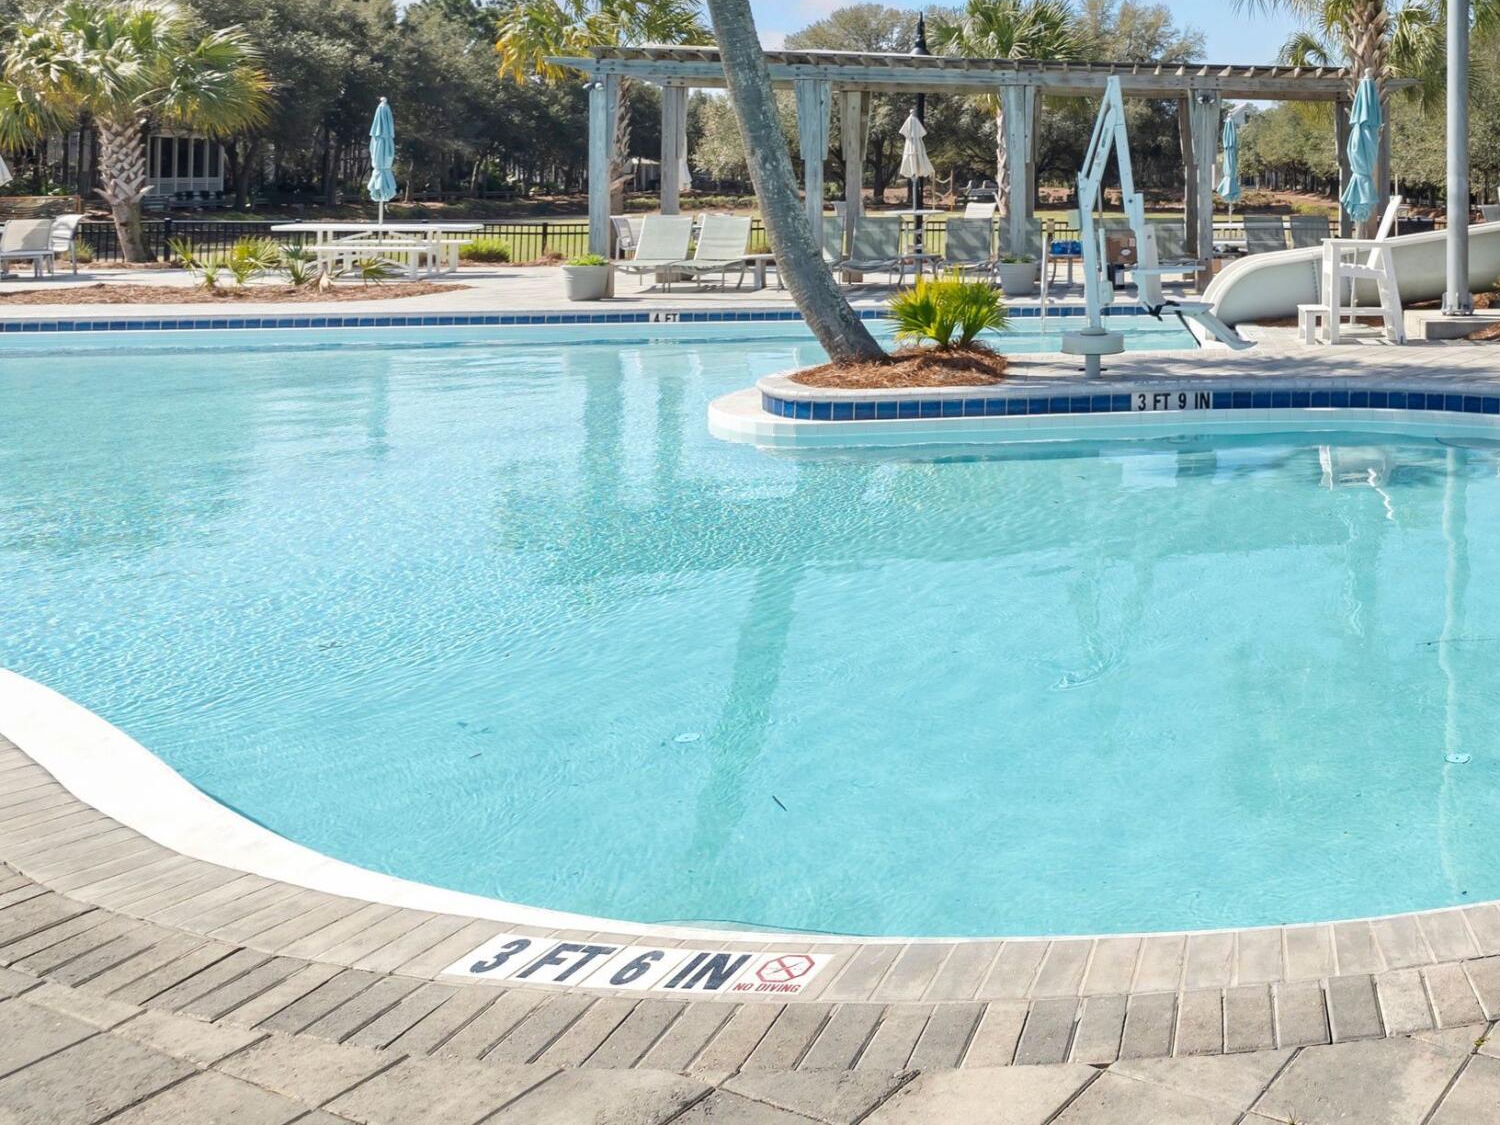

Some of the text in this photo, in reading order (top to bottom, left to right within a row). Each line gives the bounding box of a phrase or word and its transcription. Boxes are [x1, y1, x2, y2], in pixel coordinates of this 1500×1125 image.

[654, 313, 677, 322] 4 FT
[1138, 392, 1210, 411] 3 FT 9 IN
[468, 937, 753, 991] 3 FT 6 IN
[732, 982, 802, 993] NO DIVING
